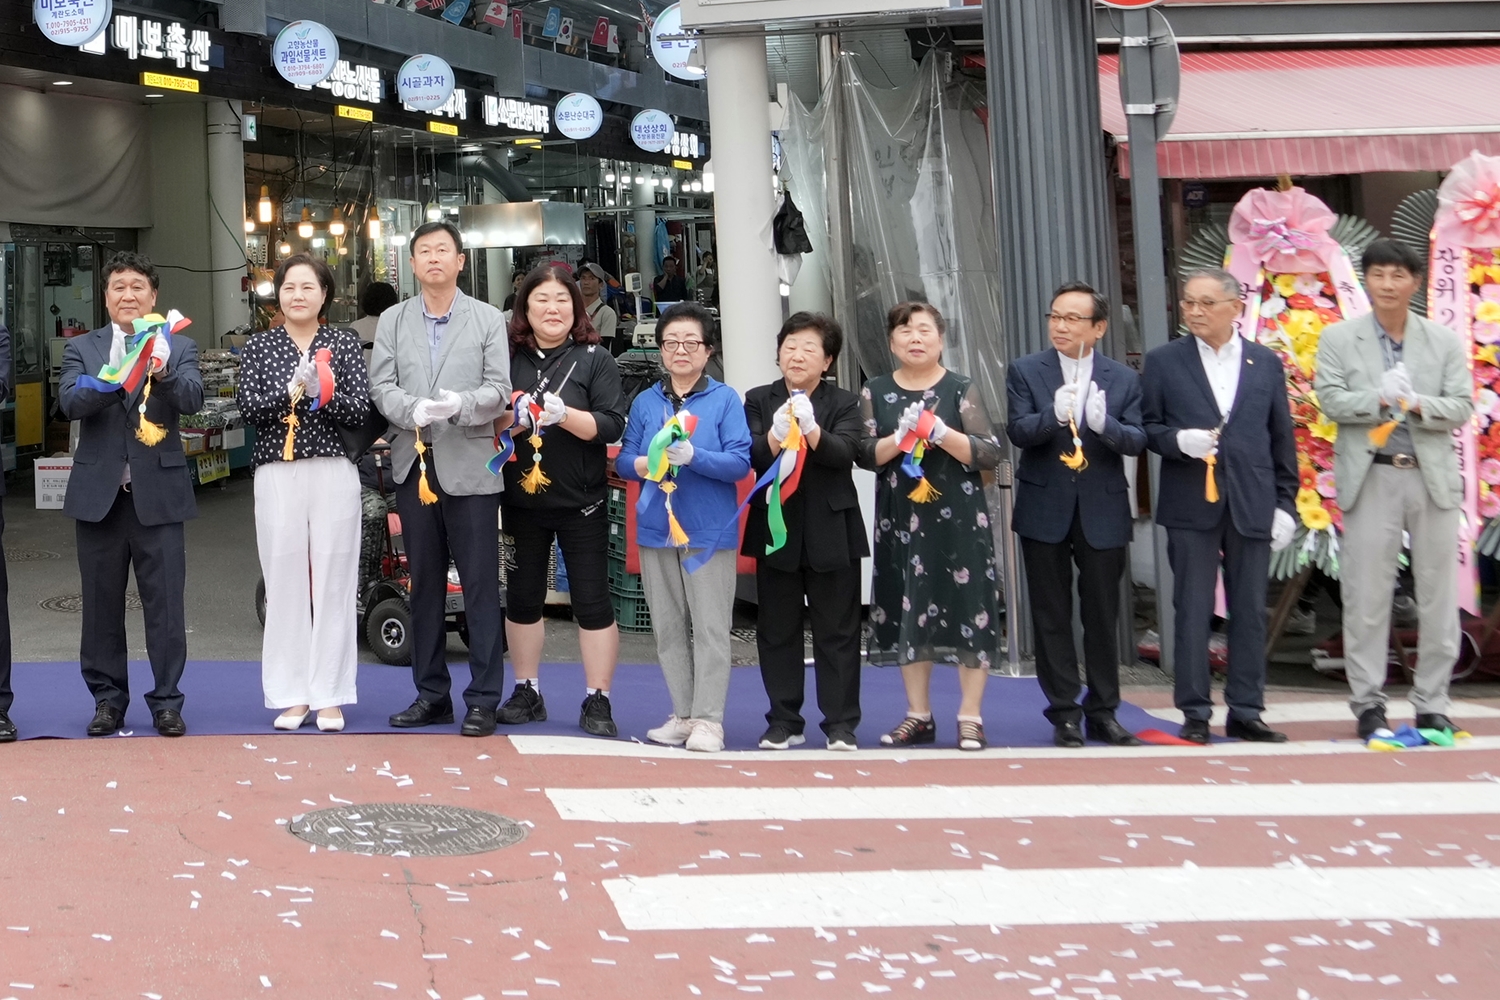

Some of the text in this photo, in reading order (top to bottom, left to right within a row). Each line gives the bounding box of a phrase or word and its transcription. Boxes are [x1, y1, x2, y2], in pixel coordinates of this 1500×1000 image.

[51, 7, 84, 19] 계란도소매
[114, 14, 211, 73] 미보축산
[287, 38, 320, 50] 고향농산물
[401, 75, 445, 88] 시골과자
[634, 123, 667, 134] 대성상회
